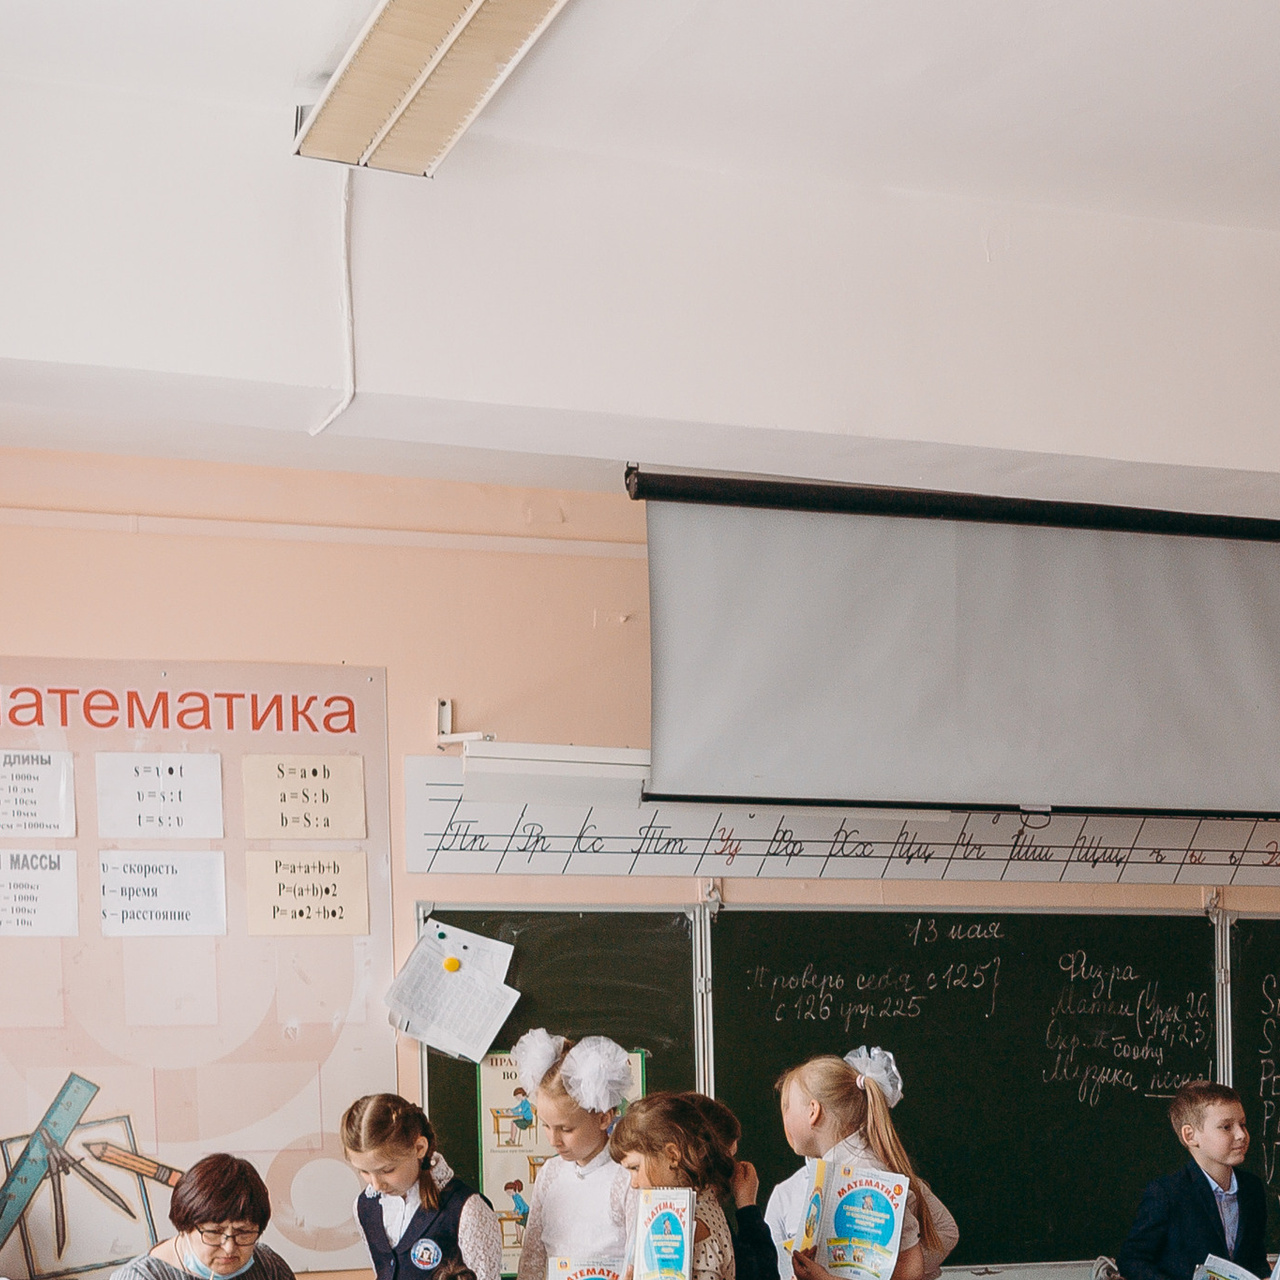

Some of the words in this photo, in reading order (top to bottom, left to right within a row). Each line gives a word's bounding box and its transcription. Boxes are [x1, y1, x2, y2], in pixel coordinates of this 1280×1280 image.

[0, 686, 357, 734] атематика
[715, 827, 742, 865] Уу
[10, 854, 61, 871] МАССЫ
[122, 863, 178, 878] скорость
[120, 886, 159, 900] время
[121, 909, 191, 924] расстояние
[905, 918, 938, 946] 13
[948, 921, 1005, 940] мая
[837, 1179, 900, 1210] МАТЕМАТИКА
